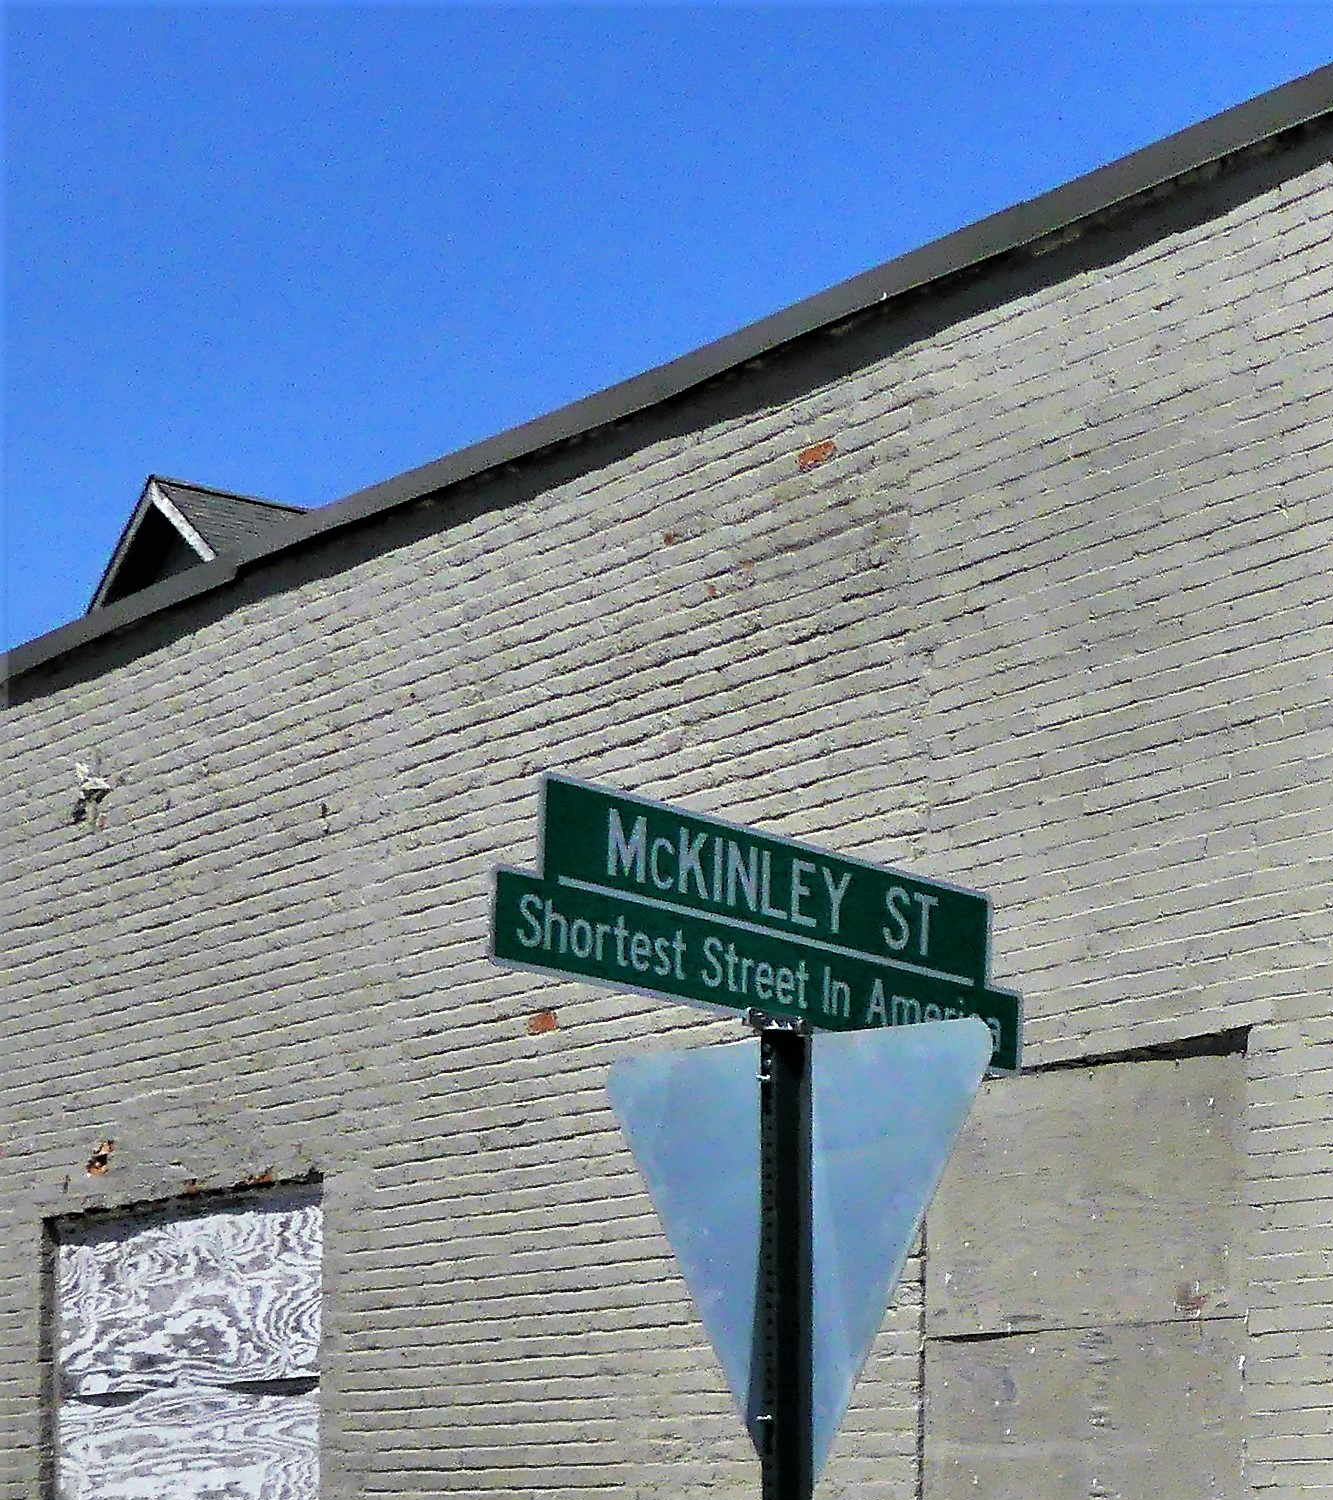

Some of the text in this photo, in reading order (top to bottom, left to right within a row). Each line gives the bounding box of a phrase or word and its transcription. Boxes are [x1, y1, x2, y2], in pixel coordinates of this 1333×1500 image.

[606, 807, 939, 957] McKINLEY ST
[515, 893, 1001, 1053] Shortest Street In Amea
